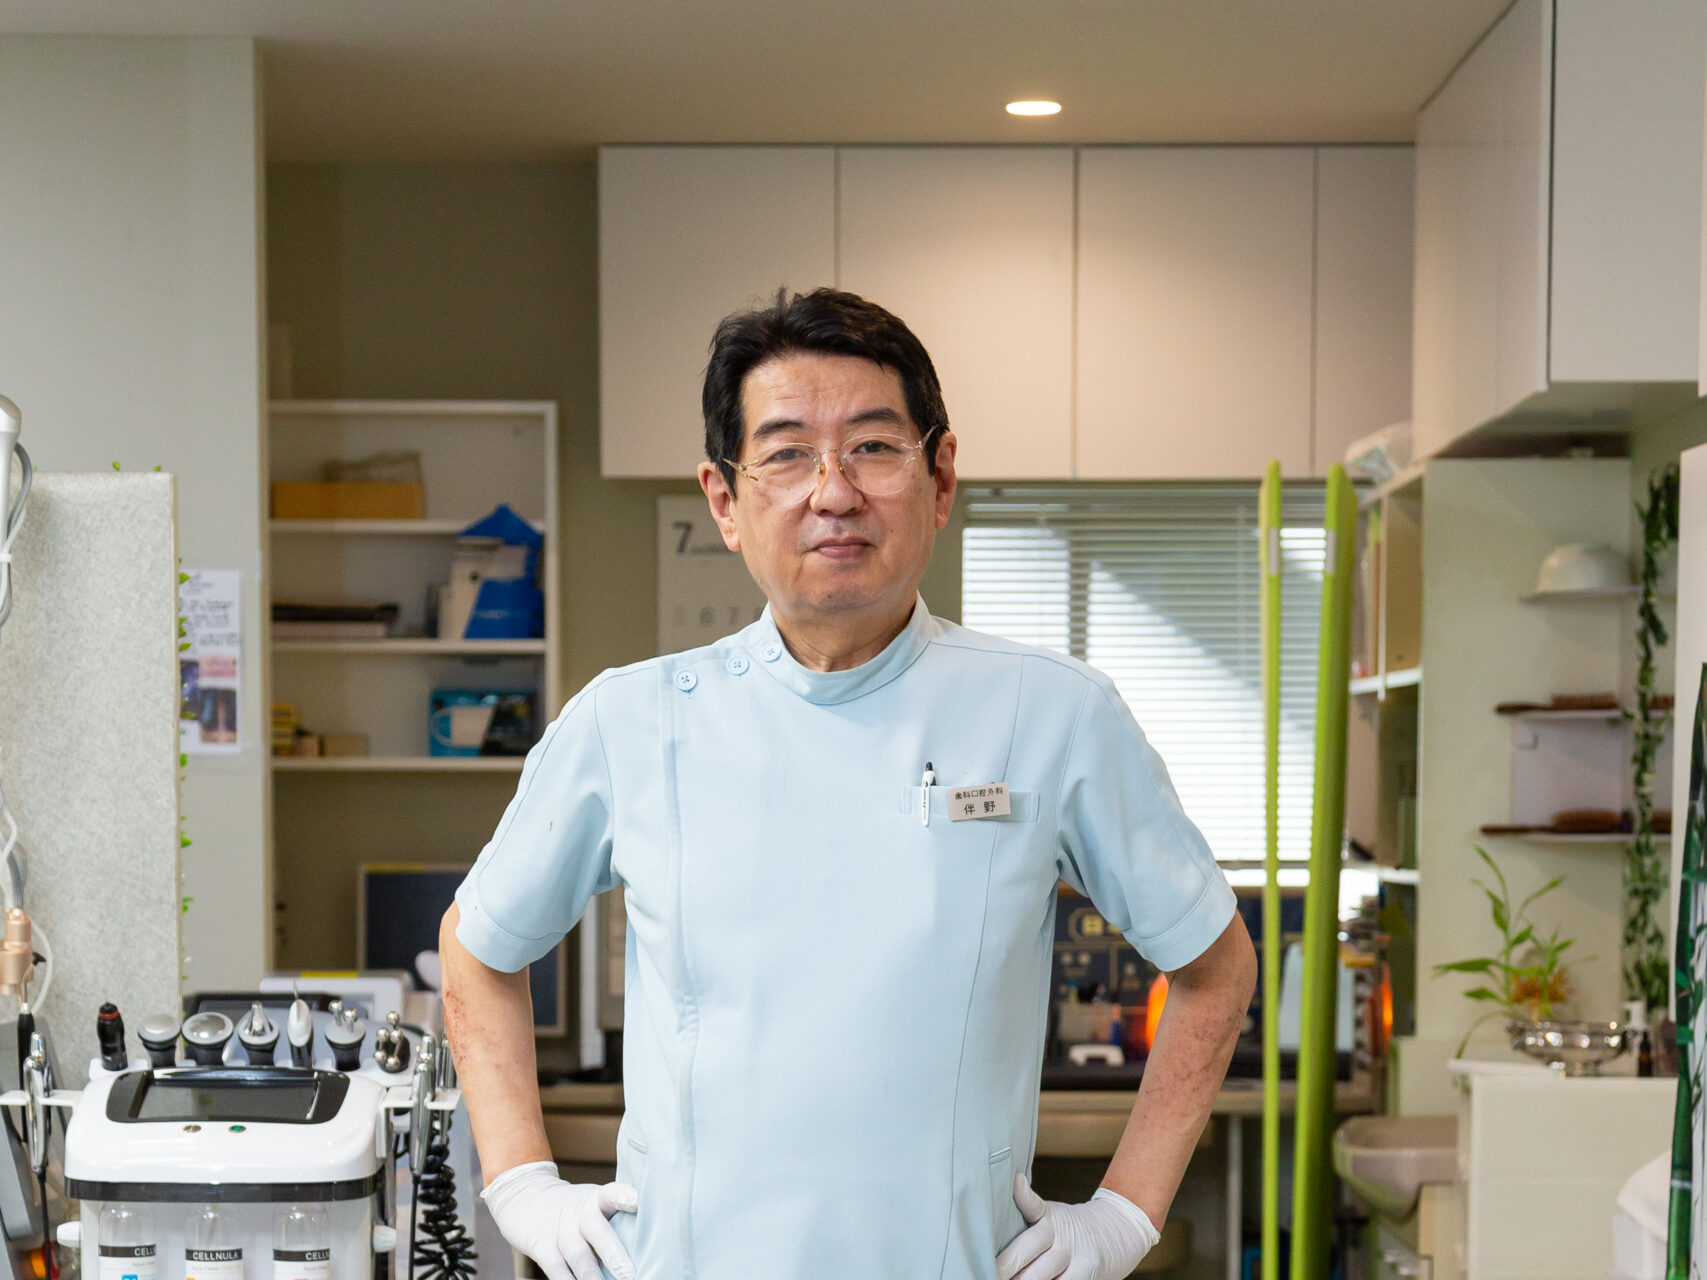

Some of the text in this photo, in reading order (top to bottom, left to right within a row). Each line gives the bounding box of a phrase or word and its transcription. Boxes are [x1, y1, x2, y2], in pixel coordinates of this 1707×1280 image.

[672, 521, 693, 553] 7
[954, 787, 1004, 800] 歯科口腔外科
[192, 1250, 238, 1261] CELLNULA
